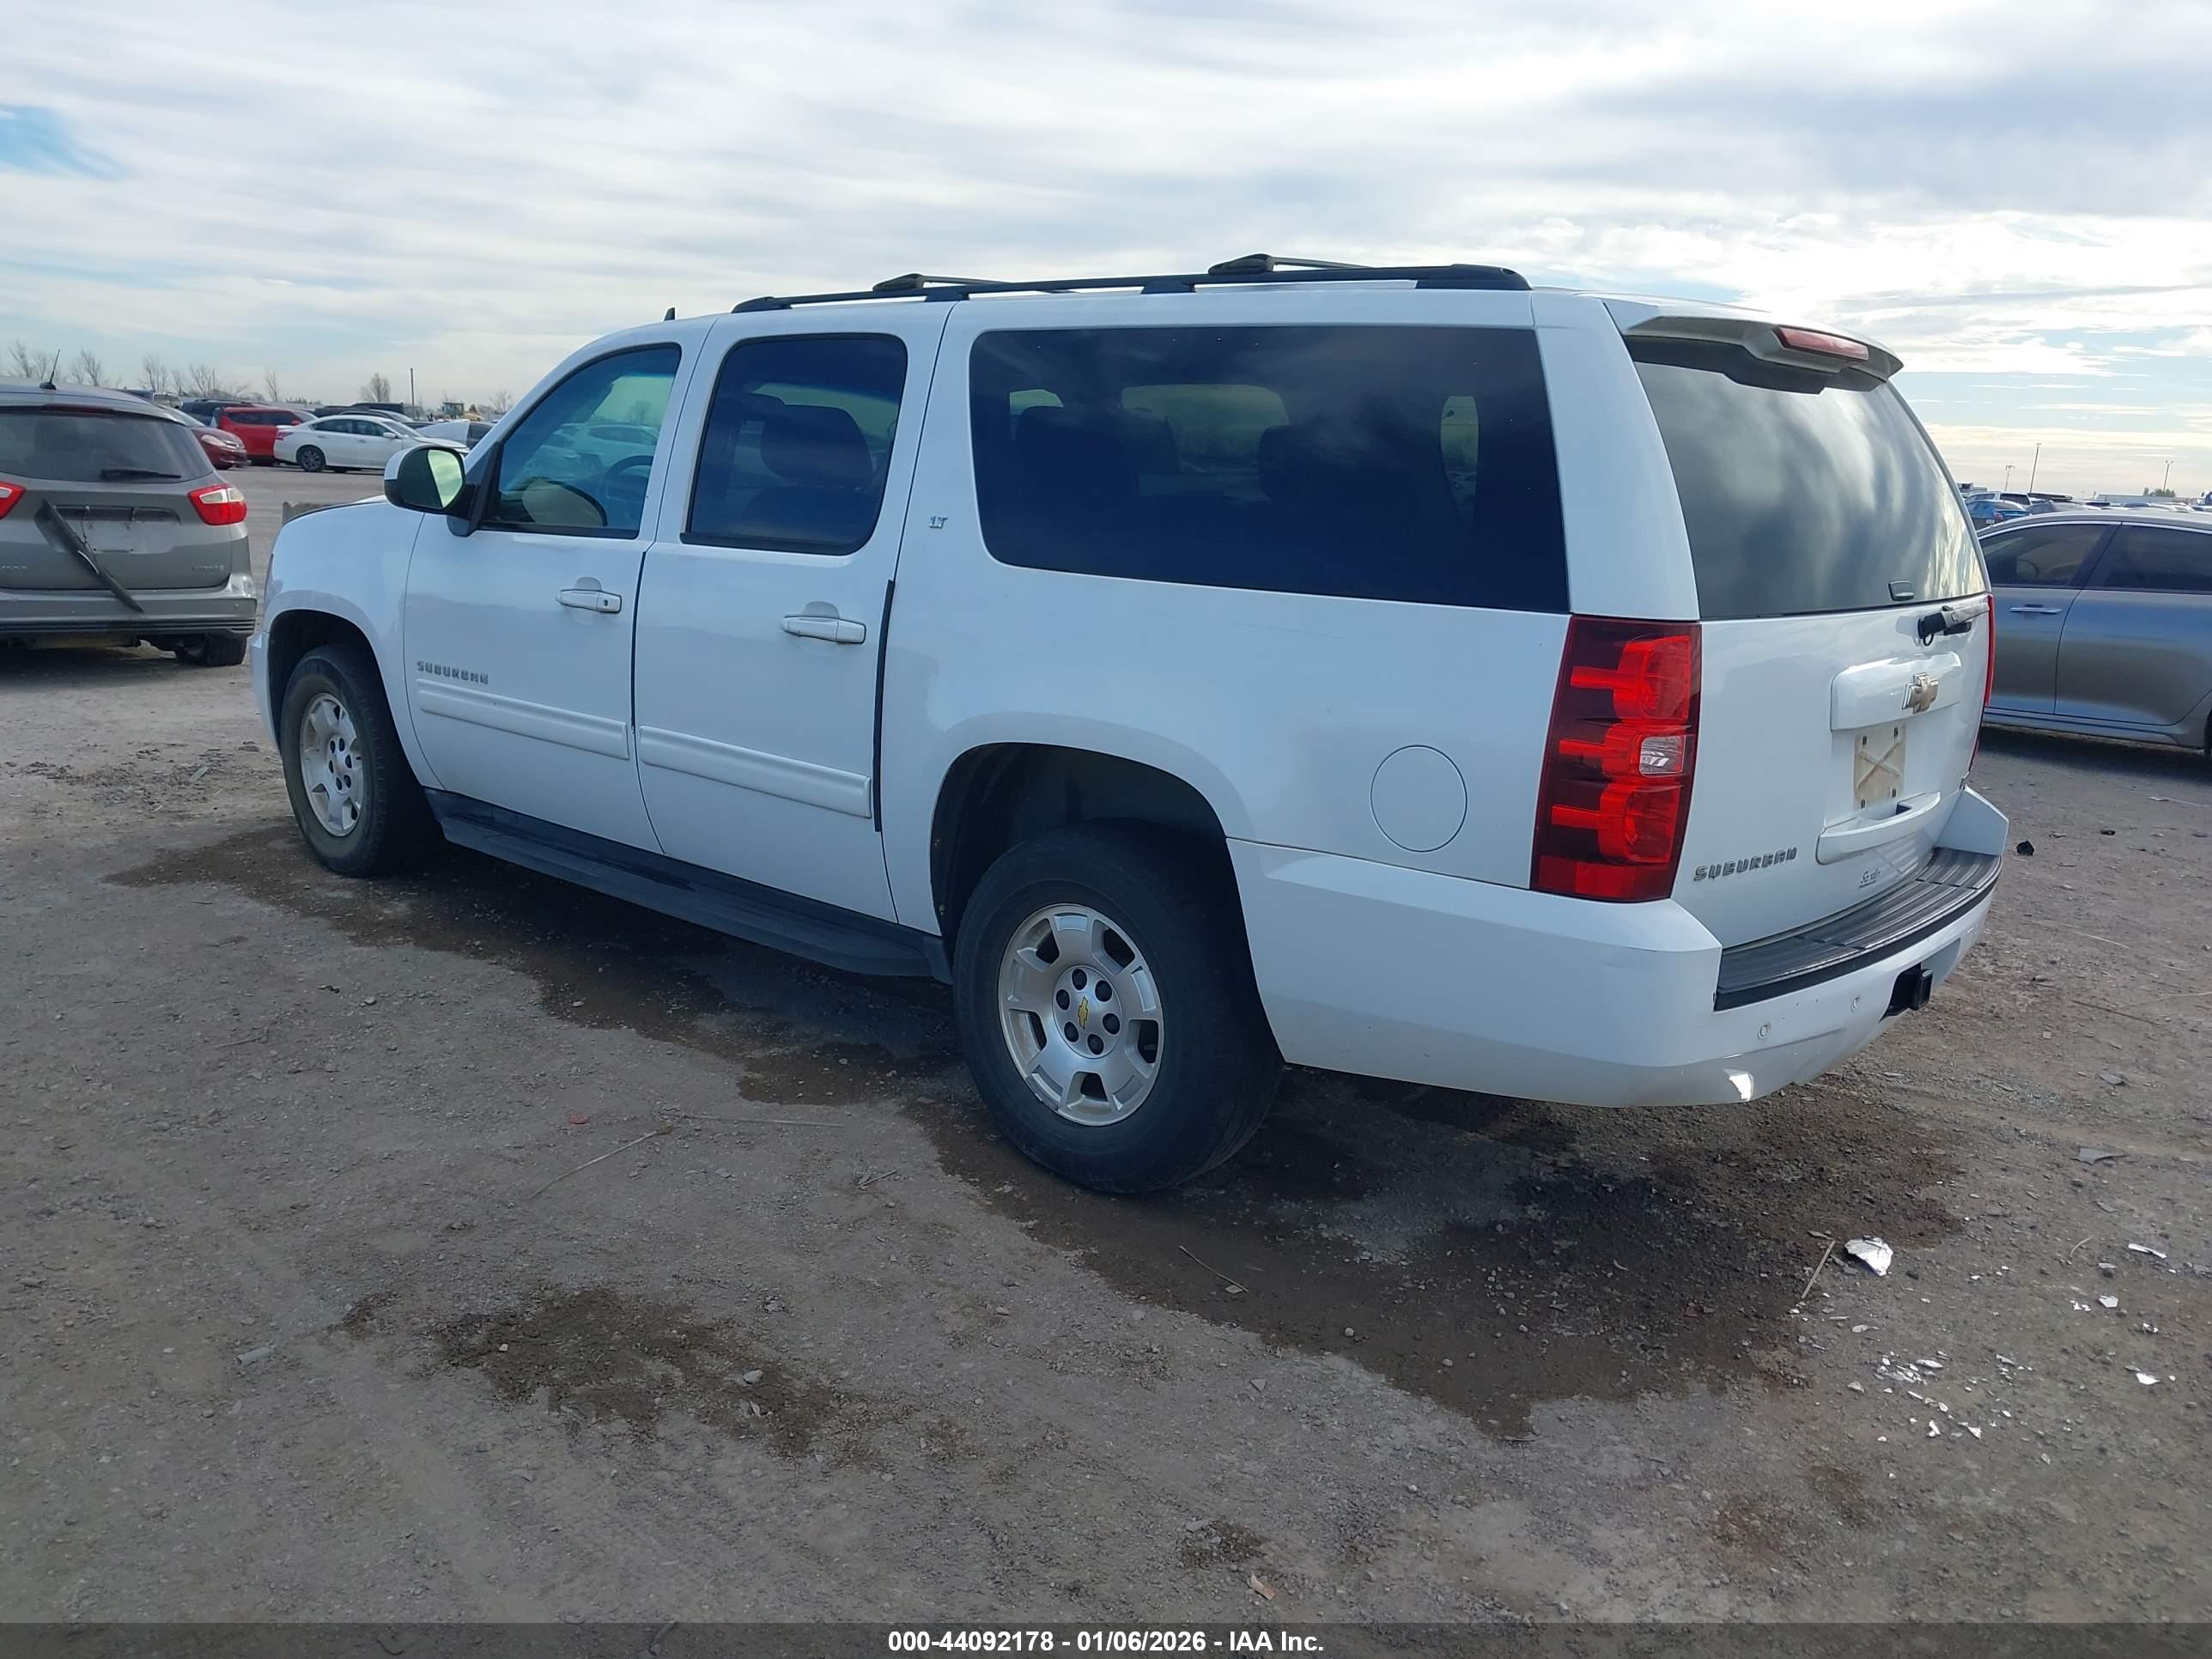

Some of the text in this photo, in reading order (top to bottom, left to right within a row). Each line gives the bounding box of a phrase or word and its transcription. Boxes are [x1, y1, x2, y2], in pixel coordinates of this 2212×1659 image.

[928, 515, 949, 530] LT
[416, 660, 489, 685] SUBURBAN
[1692, 846, 1798, 882] SUBURBAN
